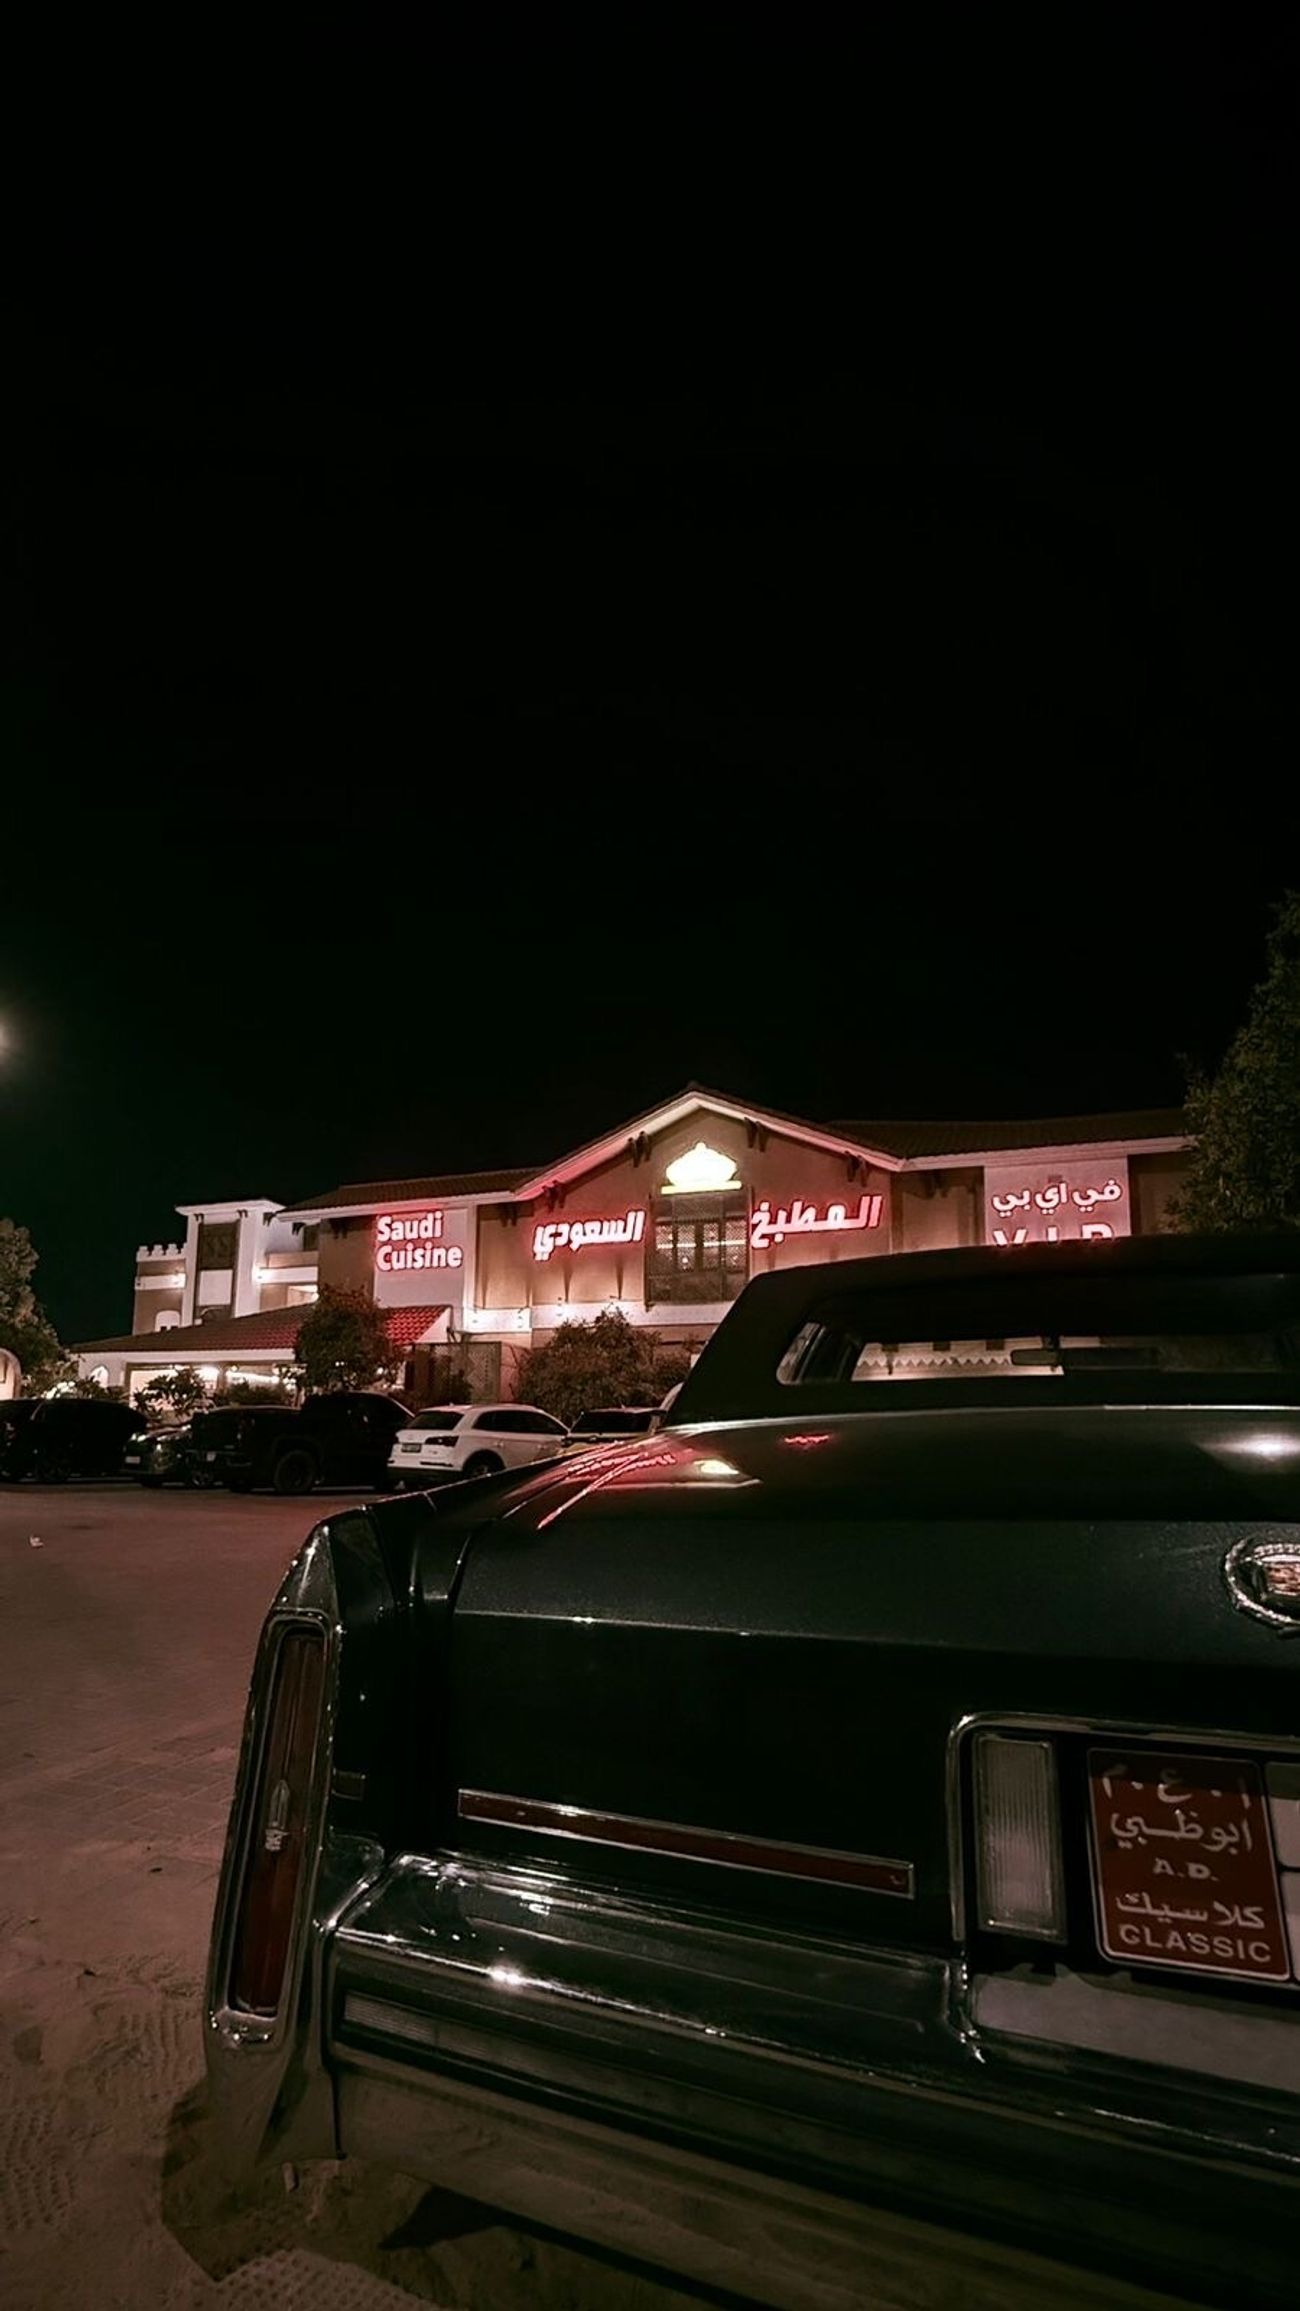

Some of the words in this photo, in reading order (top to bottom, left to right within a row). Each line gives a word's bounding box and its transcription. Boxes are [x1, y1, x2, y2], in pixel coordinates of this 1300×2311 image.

[992, 1189, 1031, 1217] بي
[1072, 1179, 1121, 1211] في
[376, 1211, 443, 1242] Saudi
[533, 1211, 645, 1260] السعودي
[751, 1195, 882, 1248] المطبخ
[376, 1243, 463, 1271] Cuisine
[1153, 1857, 1219, 1881] A.D.
[1116, 1892, 1265, 1929] كلاسيك
[1119, 1923, 1271, 1963] CLASSIC
